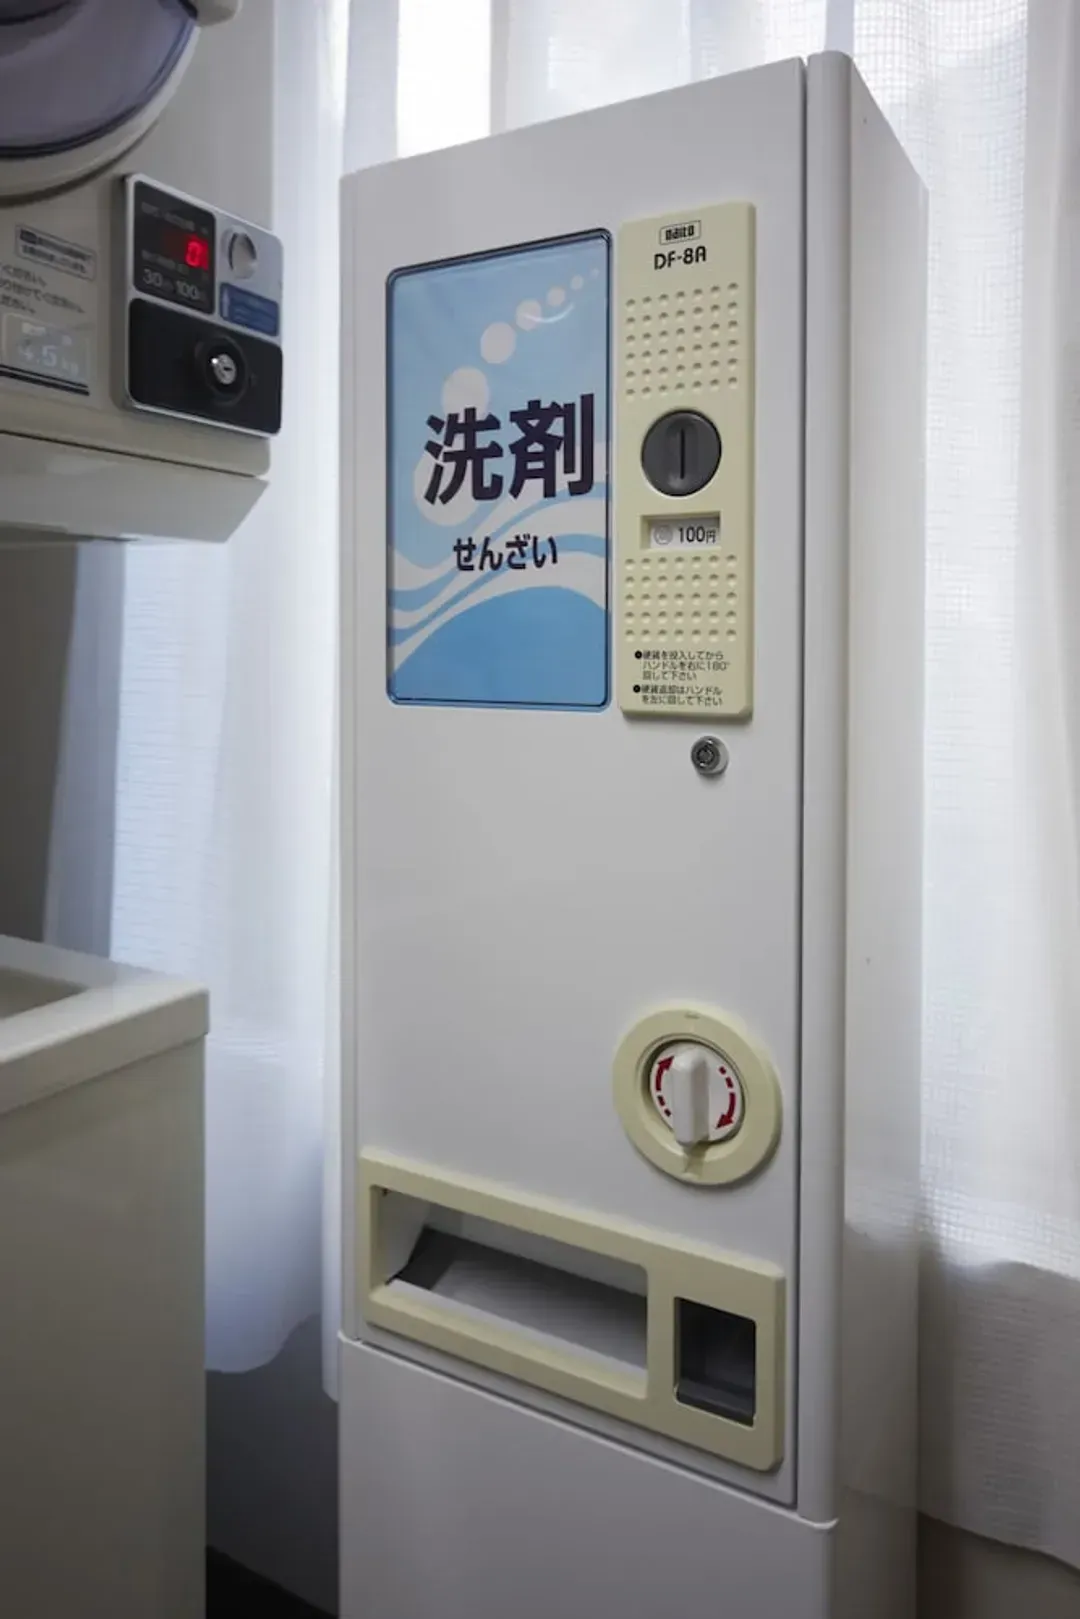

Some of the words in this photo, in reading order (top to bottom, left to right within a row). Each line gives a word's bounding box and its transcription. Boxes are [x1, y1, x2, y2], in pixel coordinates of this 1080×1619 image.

[185, 238, 203, 268] 0
[654, 245, 706, 270] DF-8A
[423, 393, 595, 505] 洗剤
[679, 526, 716, 544] 100円
[453, 534, 558, 571] せんざい
[642, 671, 697, 681] 回して下さい
